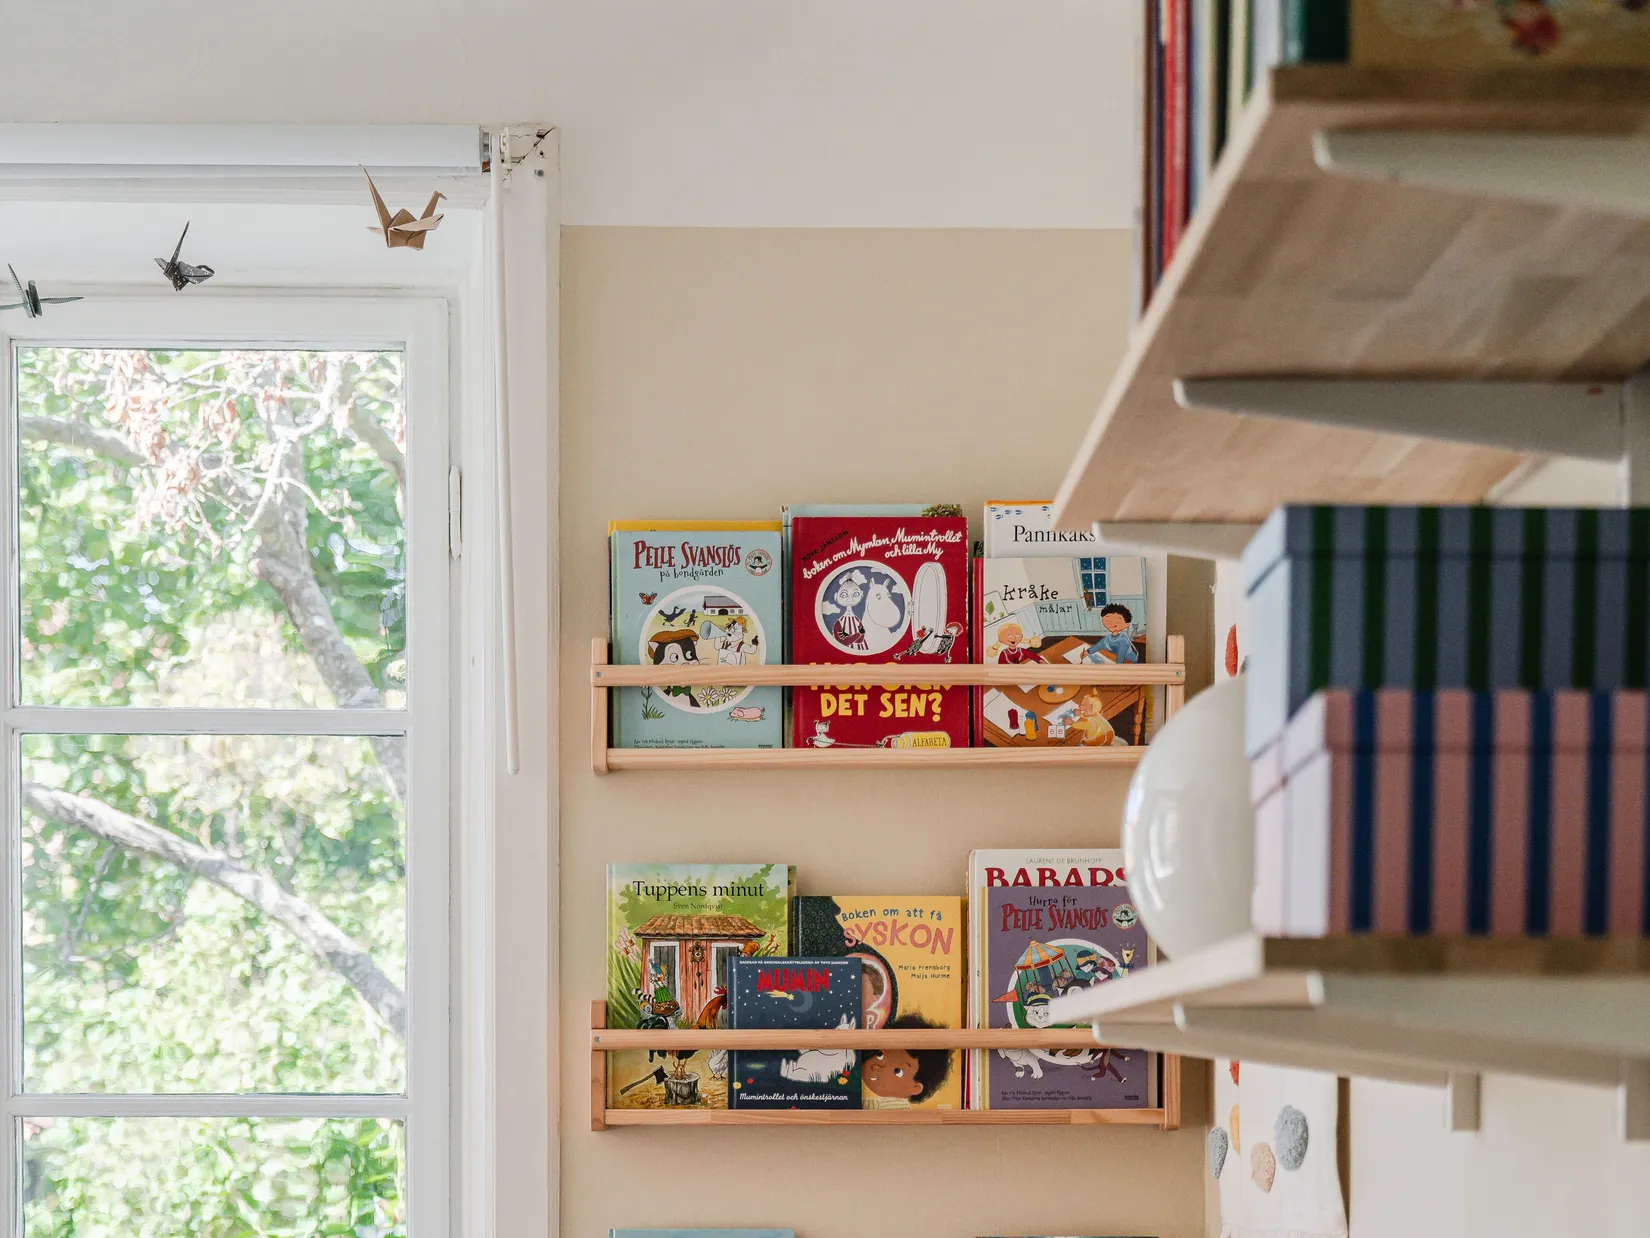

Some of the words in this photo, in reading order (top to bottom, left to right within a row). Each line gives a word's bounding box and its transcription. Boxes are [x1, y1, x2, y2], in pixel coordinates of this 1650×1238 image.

[633, 540, 676, 569] PELLE
[802, 549, 819, 561] TOVE
[821, 530, 848, 551] JANSSON
[803, 559, 833, 579] boken
[832, 551, 847, 562] om
[891, 527, 962, 543] Mumintrollet
[884, 544, 902, 558] och
[901, 544, 922, 555] lilla
[923, 542, 944, 560] My
[659, 570, 670, 582] på
[673, 567, 724, 582] bondgården
[1002, 584, 1059, 601] kråke
[1039, 603, 1072, 614] målar
[820, 692, 869, 718] DET
[878, 692, 943, 723] SEN?
[912, 737, 947, 748] ALFABETA
[632, 880, 707, 902] Tuppens
[713, 882, 764, 897] minut
[690, 902, 724, 911] Nordqvist
[1029, 896, 1058, 907] Hurra
[1062, 895, 1078, 907] för
[841, 908, 877, 922] Boken
[882, 908, 899, 917] om
[905, 908, 924, 918] att
[930, 910, 942, 921] få
[1001, 903, 1044, 932] PELLE
[843, 919, 954, 955] SYSKON
[756, 968, 829, 993] MUMIN
[739, 1092, 785, 1100] Mumintrollet
[799, 1093, 848, 1102] önskestjärnan
